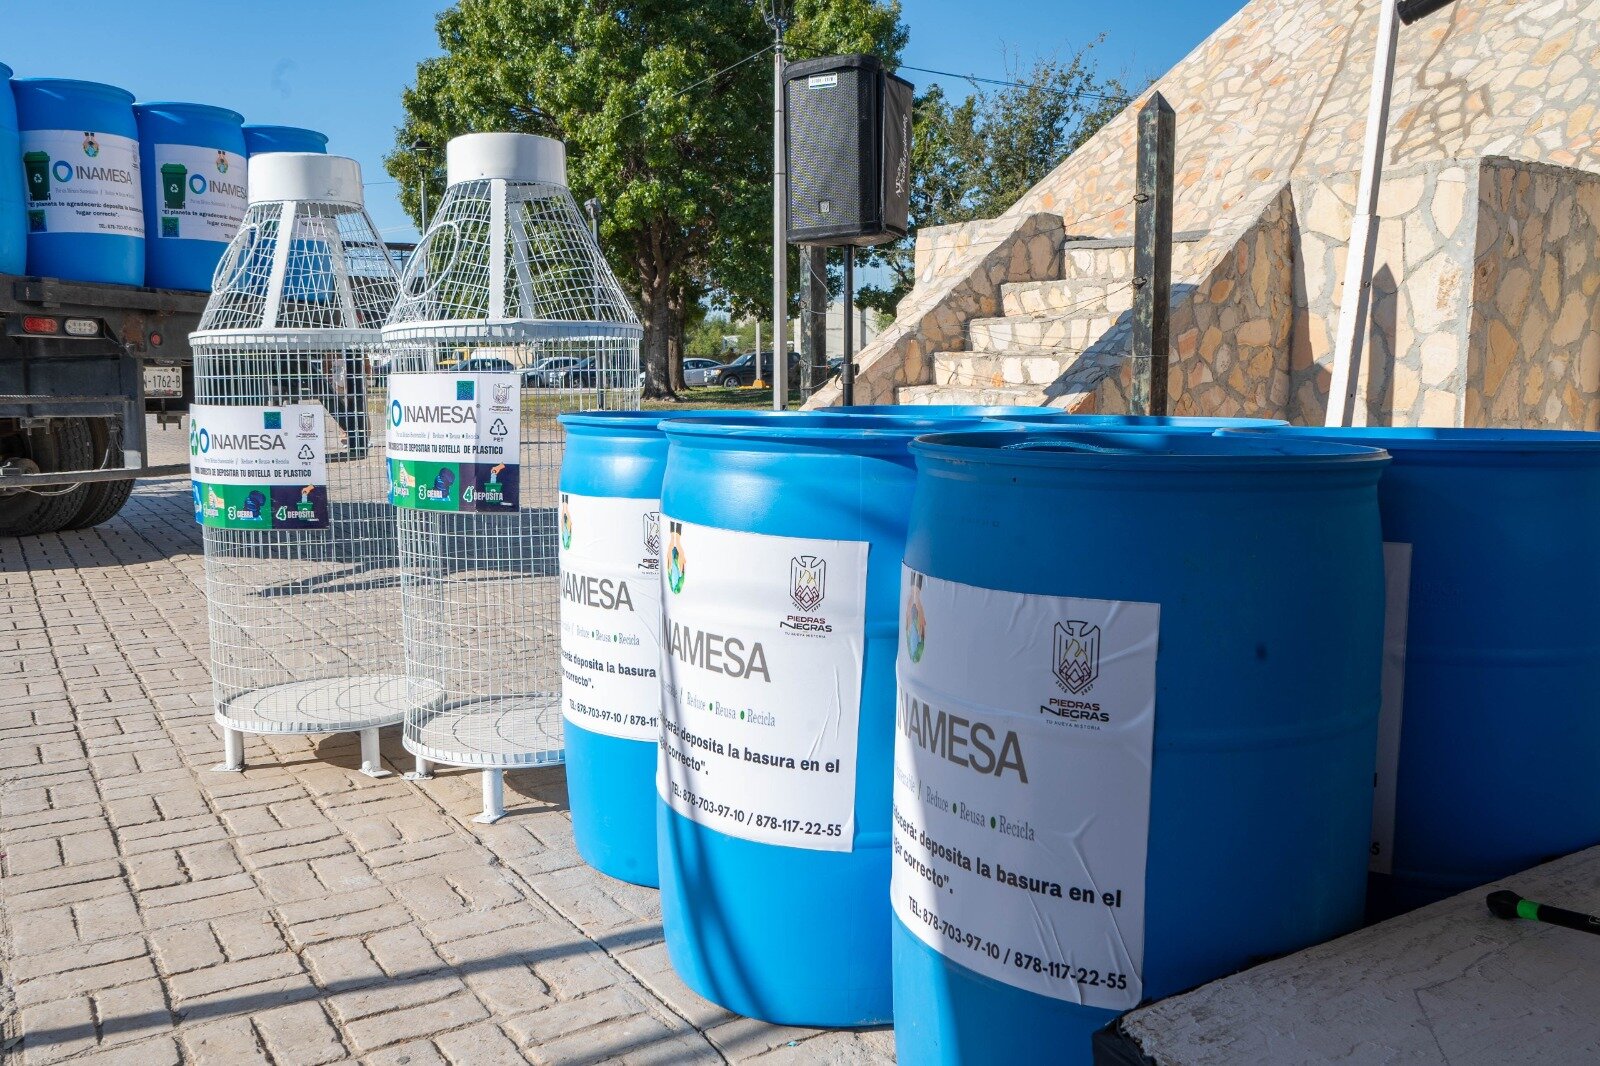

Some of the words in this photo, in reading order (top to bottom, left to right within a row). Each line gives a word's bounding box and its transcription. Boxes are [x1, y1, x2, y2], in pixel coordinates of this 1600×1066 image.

[76, 166, 132, 184] INAMESA
[405, 406, 477, 423] INAMESA
[212, 434, 286, 450] INAMESA
[409, 444, 430, 452] DEPOSITAR
[432, 445, 437, 453] TU
[438, 445, 460, 454] BOTELLA
[464, 445, 471, 454] DE
[473, 446, 503, 454] PLASTICO
[216, 469, 239, 477] DEPOSITAR
[474, 492, 503, 500] DEPOSITA
[560, 571, 634, 612] NAMESA
[780, 621, 832, 632] NEGRAS
[787, 615, 826, 624] PIEDRAS
[619, 633, 640, 646] Recicla
[574, 655, 604, 672] deposita
[606, 662, 615, 672] la
[618, 663, 656, 678] basura
[577, 703, 621, 723] 878-703-97-10
[624, 714, 628, 725] /
[1040, 705, 1110, 722] NEGRAS
[1049, 698, 1100, 711] PIEDRAS
[715, 702, 736, 720] Reusa
[747, 707, 776, 728] Recicla
[668, 744, 709, 775] correcto".
[680, 728, 724, 756] deposita
[728, 744, 740, 758] la
[744, 748, 795, 769] basura
[800, 761, 820, 772] en
[825, 759, 840, 774] el
[671, 780, 682, 797] TEL:
[683, 788, 745, 822] 878-703-97-10
[747, 812, 754, 825] /
[756, 814, 842, 836] 878-117-22-55
[926, 785, 949, 812] Reduce
[960, 802, 986, 827] Reusa
[999, 814, 1035, 841] Recicla
[904, 848, 953, 894] correcto".
[920, 830, 972, 872] deposita
[976, 857, 992, 881] la
[997, 868, 1063, 899] basura
[1069, 886, 1095, 903] en
[1102, 890, 1121, 908] el
[908, 896, 922, 919] TEL:
[923, 908, 1000, 960] 878-703-97-10
[1003, 947, 1011, 964] /
[1014, 952, 1127, 990] 878-117-22-55
